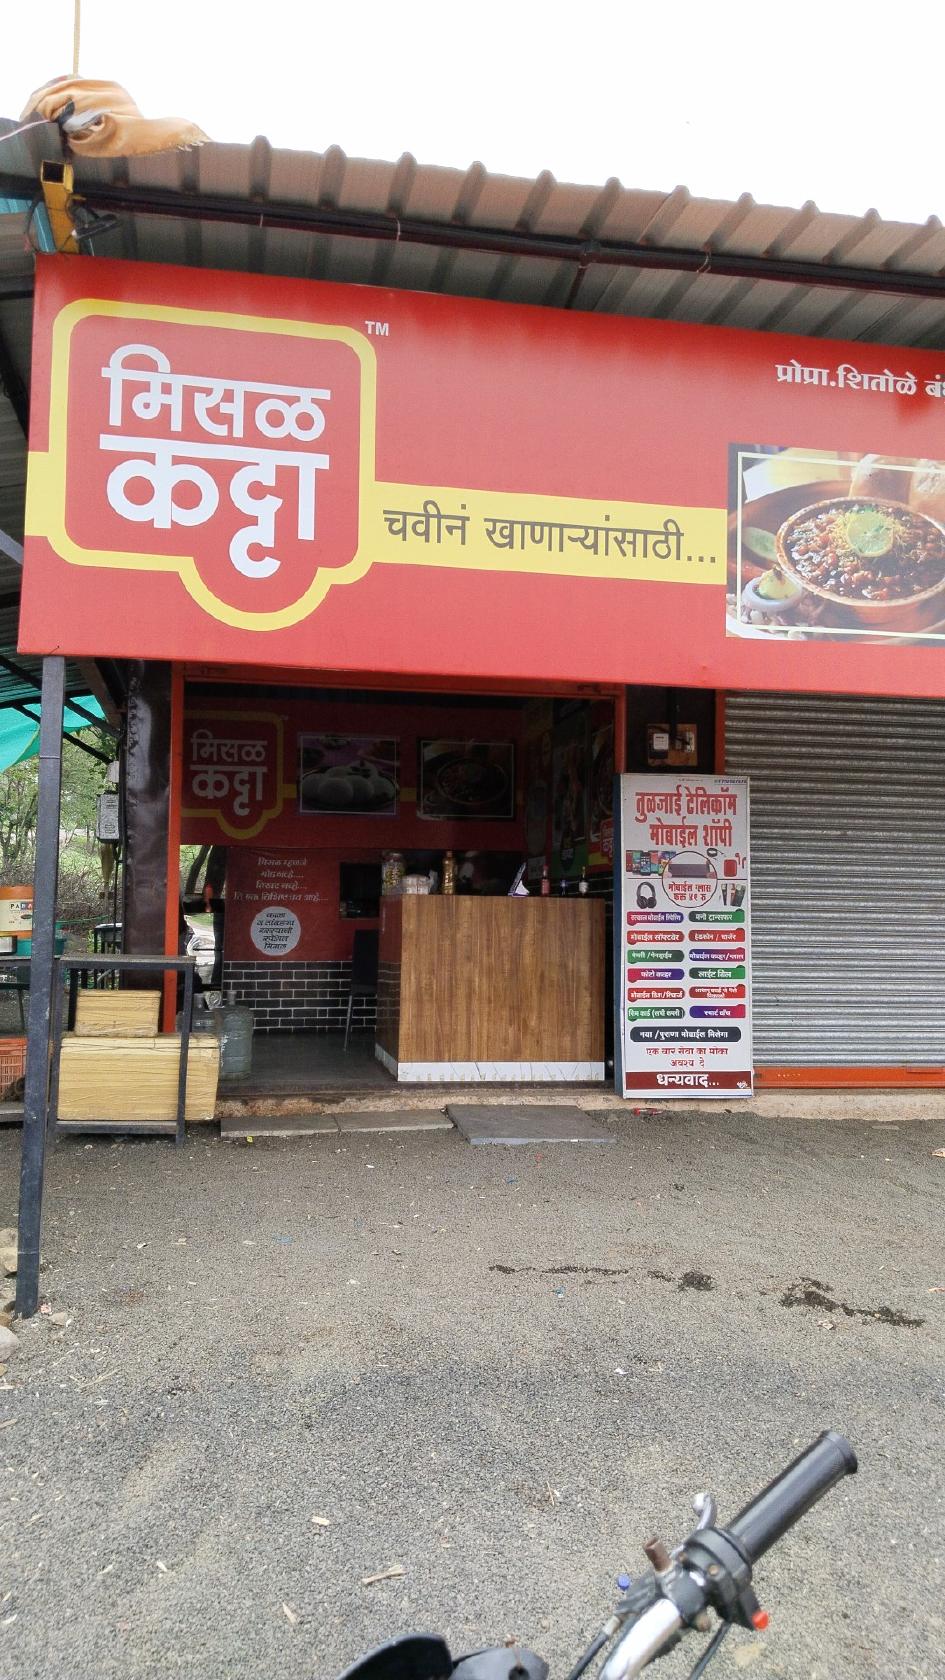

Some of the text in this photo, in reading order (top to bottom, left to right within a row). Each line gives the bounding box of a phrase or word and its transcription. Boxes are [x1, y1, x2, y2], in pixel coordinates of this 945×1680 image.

[365, 321, 390, 337] TM
[101, 343, 331, 442] मिसळ
[775, 359, 918, 396] प्रोप्रा.शितोळे
[99, 434, 330, 579] कट्टा
[383, 499, 470, 545] चवीनं
[190, 729, 268, 762] मिसळ
[189, 765, 268, 816] कट्टा
[635, 784, 737, 823] तुळजाई टेलिकॉम
[650, 816, 732, 848] मोबाईल शॉपी
[668, 881, 711, 892] मोबाईल ग्लास
[681, 1029, 706, 1039] मोबाईल
[707, 1029, 729, 1038] मिलेगा
[646, 1047, 660, 1056] एक
[678, 1046, 694, 1055] सेवा
[696, 1047, 707, 1055] का
[670, 1059, 695, 1068] अवश्य
[656, 1073, 720, 1088] धन्यवाद...
